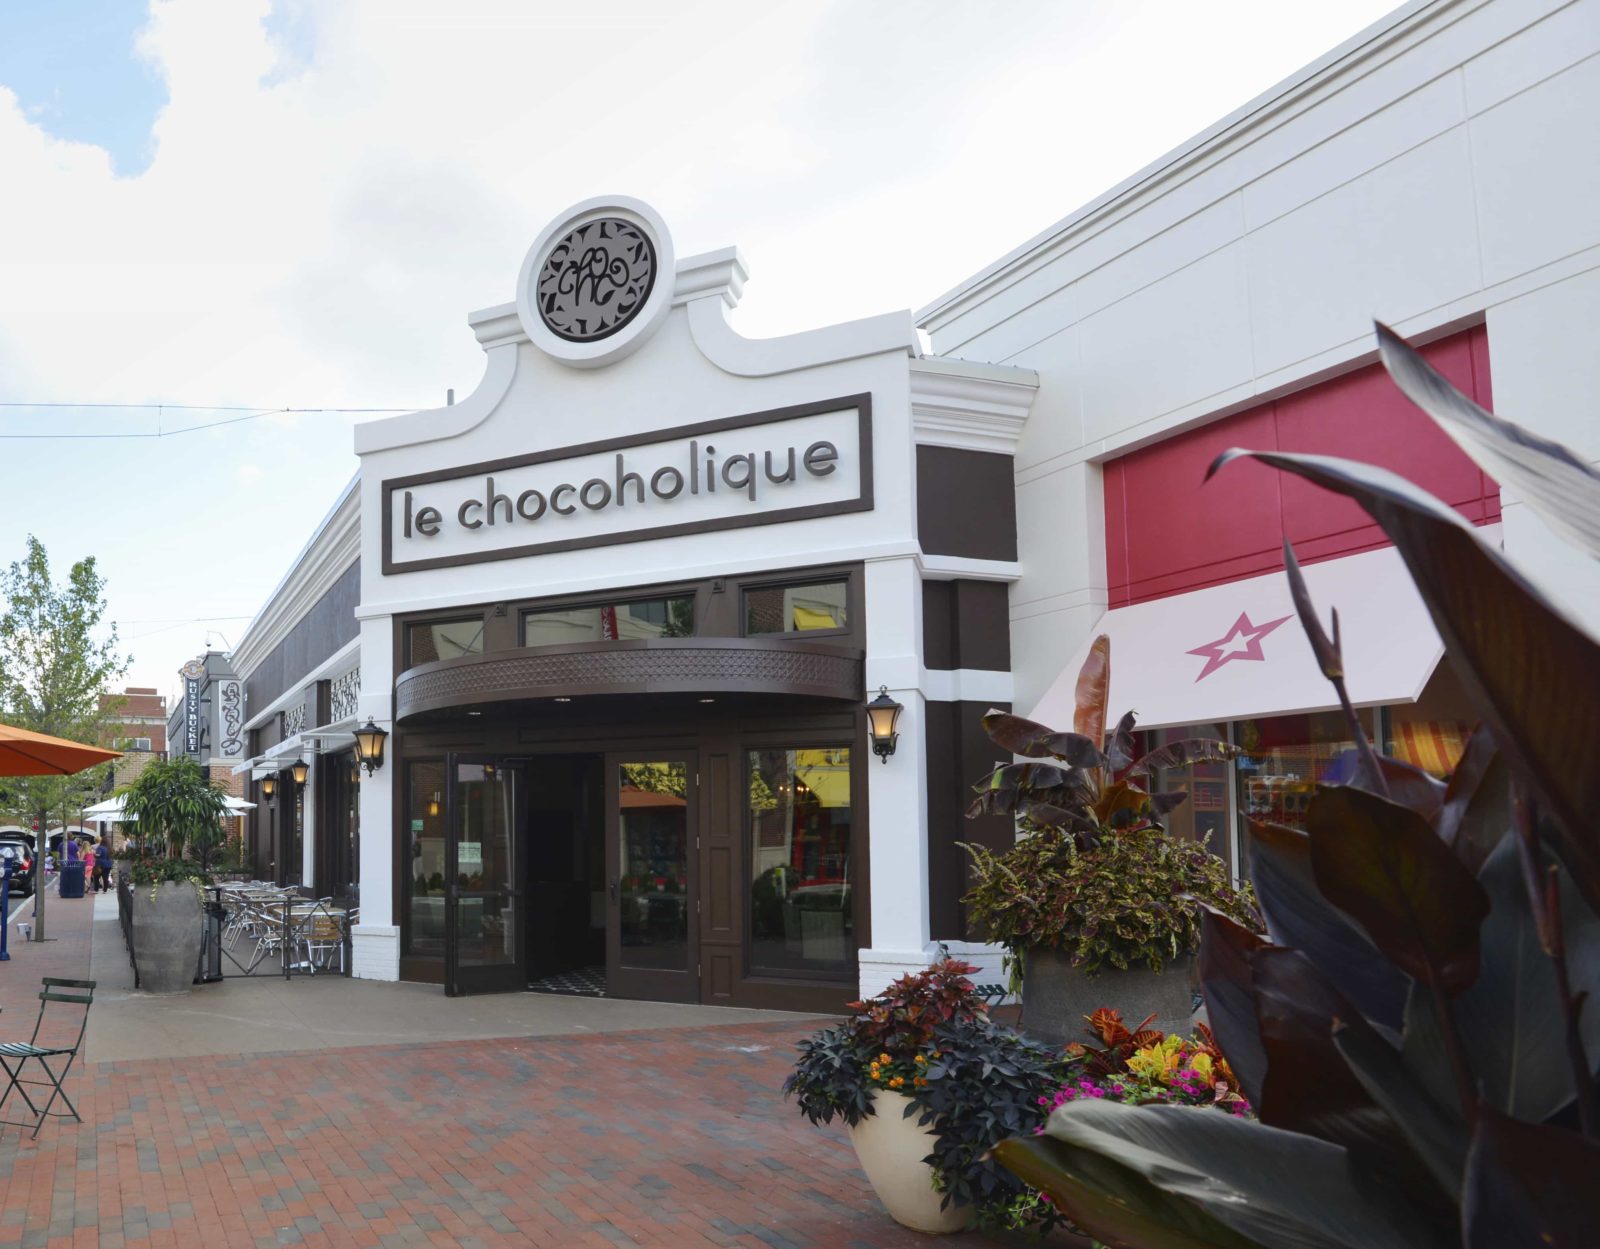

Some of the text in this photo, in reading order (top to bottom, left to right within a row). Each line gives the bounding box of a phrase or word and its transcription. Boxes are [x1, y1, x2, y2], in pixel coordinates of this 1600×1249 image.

[404, 440, 838, 538] le chocoholique
[188, 681, 198, 712] RUSTY
[188, 713, 198, 751] BUCKET
